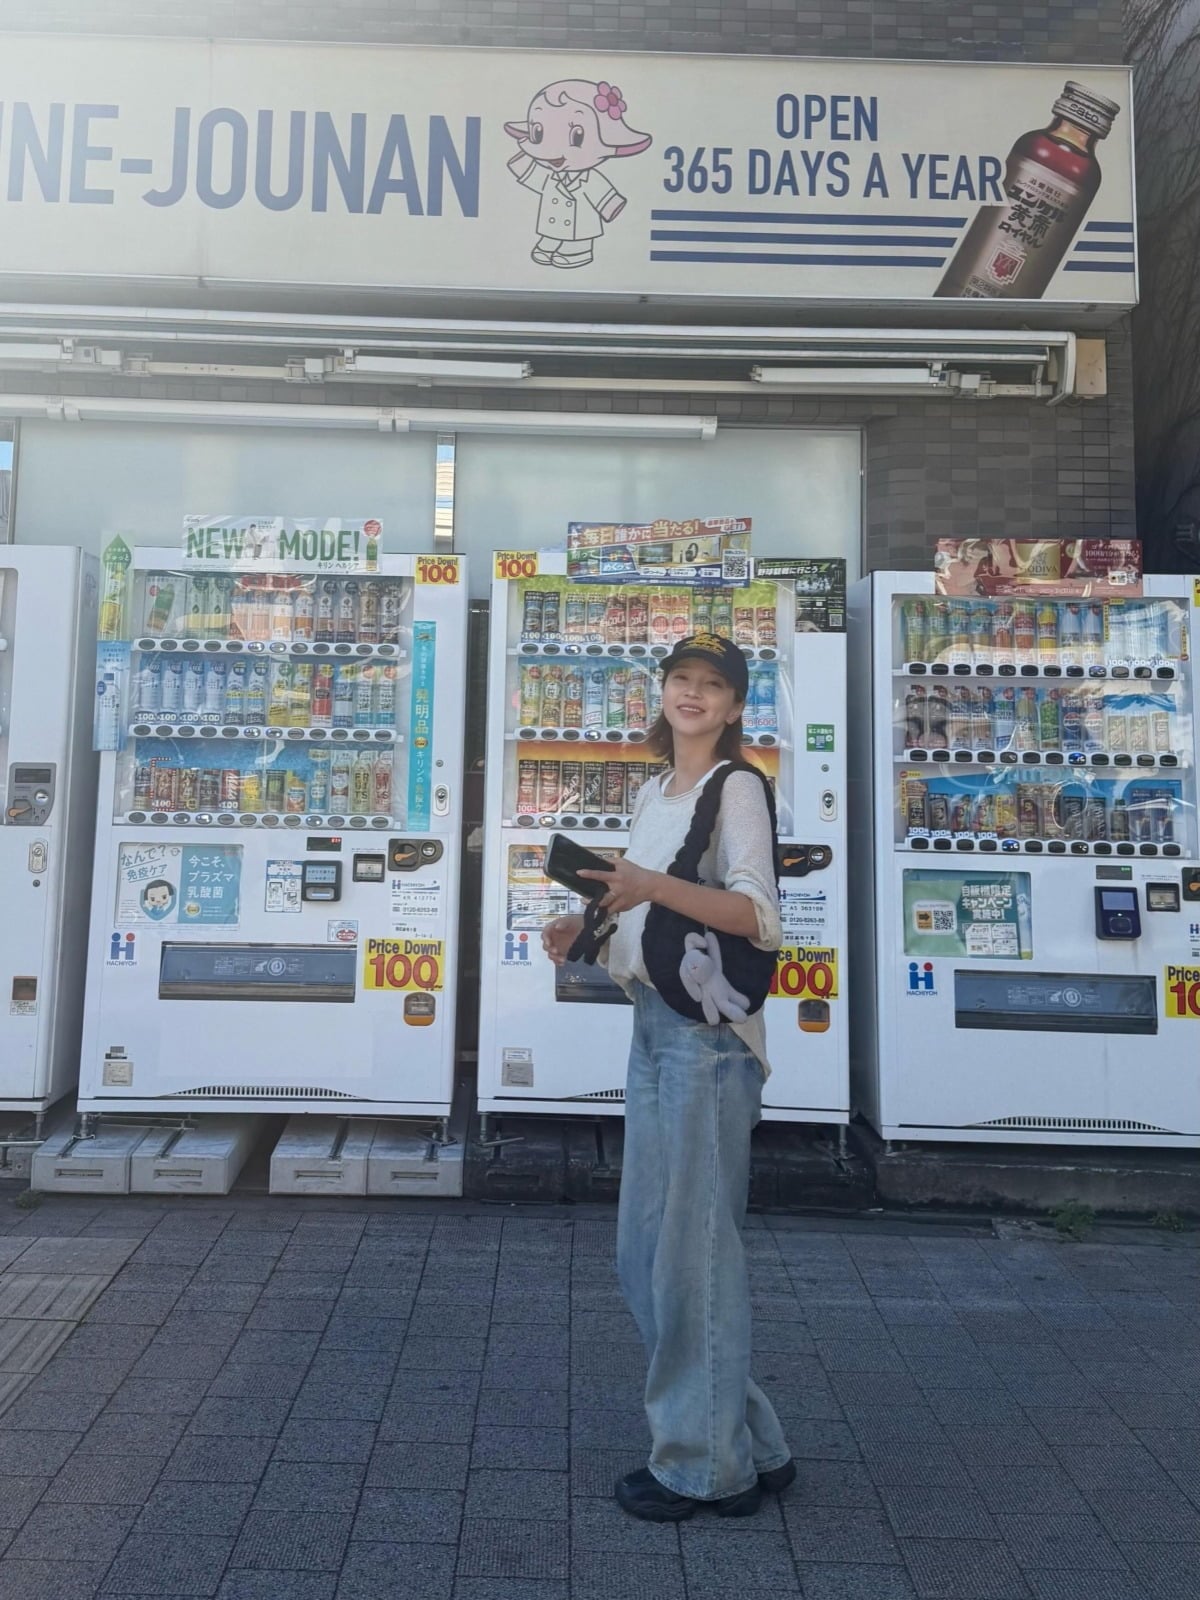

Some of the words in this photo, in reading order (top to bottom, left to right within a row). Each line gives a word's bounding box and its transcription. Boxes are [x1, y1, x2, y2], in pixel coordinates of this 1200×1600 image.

[776, 93, 878, 142] OPEN
[1069, 103, 1100, 124] sato
[0, 101, 481, 218] NE-JOUNAN
[663, 146, 733, 195] 365
[748, 148, 851, 199] DAYS
[863, 152, 890, 199] A
[901, 152, 1003, 202] YEAR
[998, 220, 1043, 249] ロイヤル
[187, 527, 247, 559] NEW
[279, 530, 361, 562] MODE!
[418, 557, 435, 565] Price
[438, 557, 458, 566] Down!
[497, 560, 537, 577] 100
[419, 565, 457, 583] 100
[415, 688, 429, 735] 発明品
[126, 864, 168, 881] 免疫ケア
[188, 870, 234, 883] プラズマ
[187, 886, 224, 899] 乳酸菌
[962, 898, 1012, 909] キャンペーン
[368, 939, 400, 954] Price
[404, 940, 442, 956] Down!
[797, 949, 835, 963] Down!
[369, 954, 439, 988] 100
[769, 961, 834, 997] 100
[1168, 965, 1200, 982] Price
